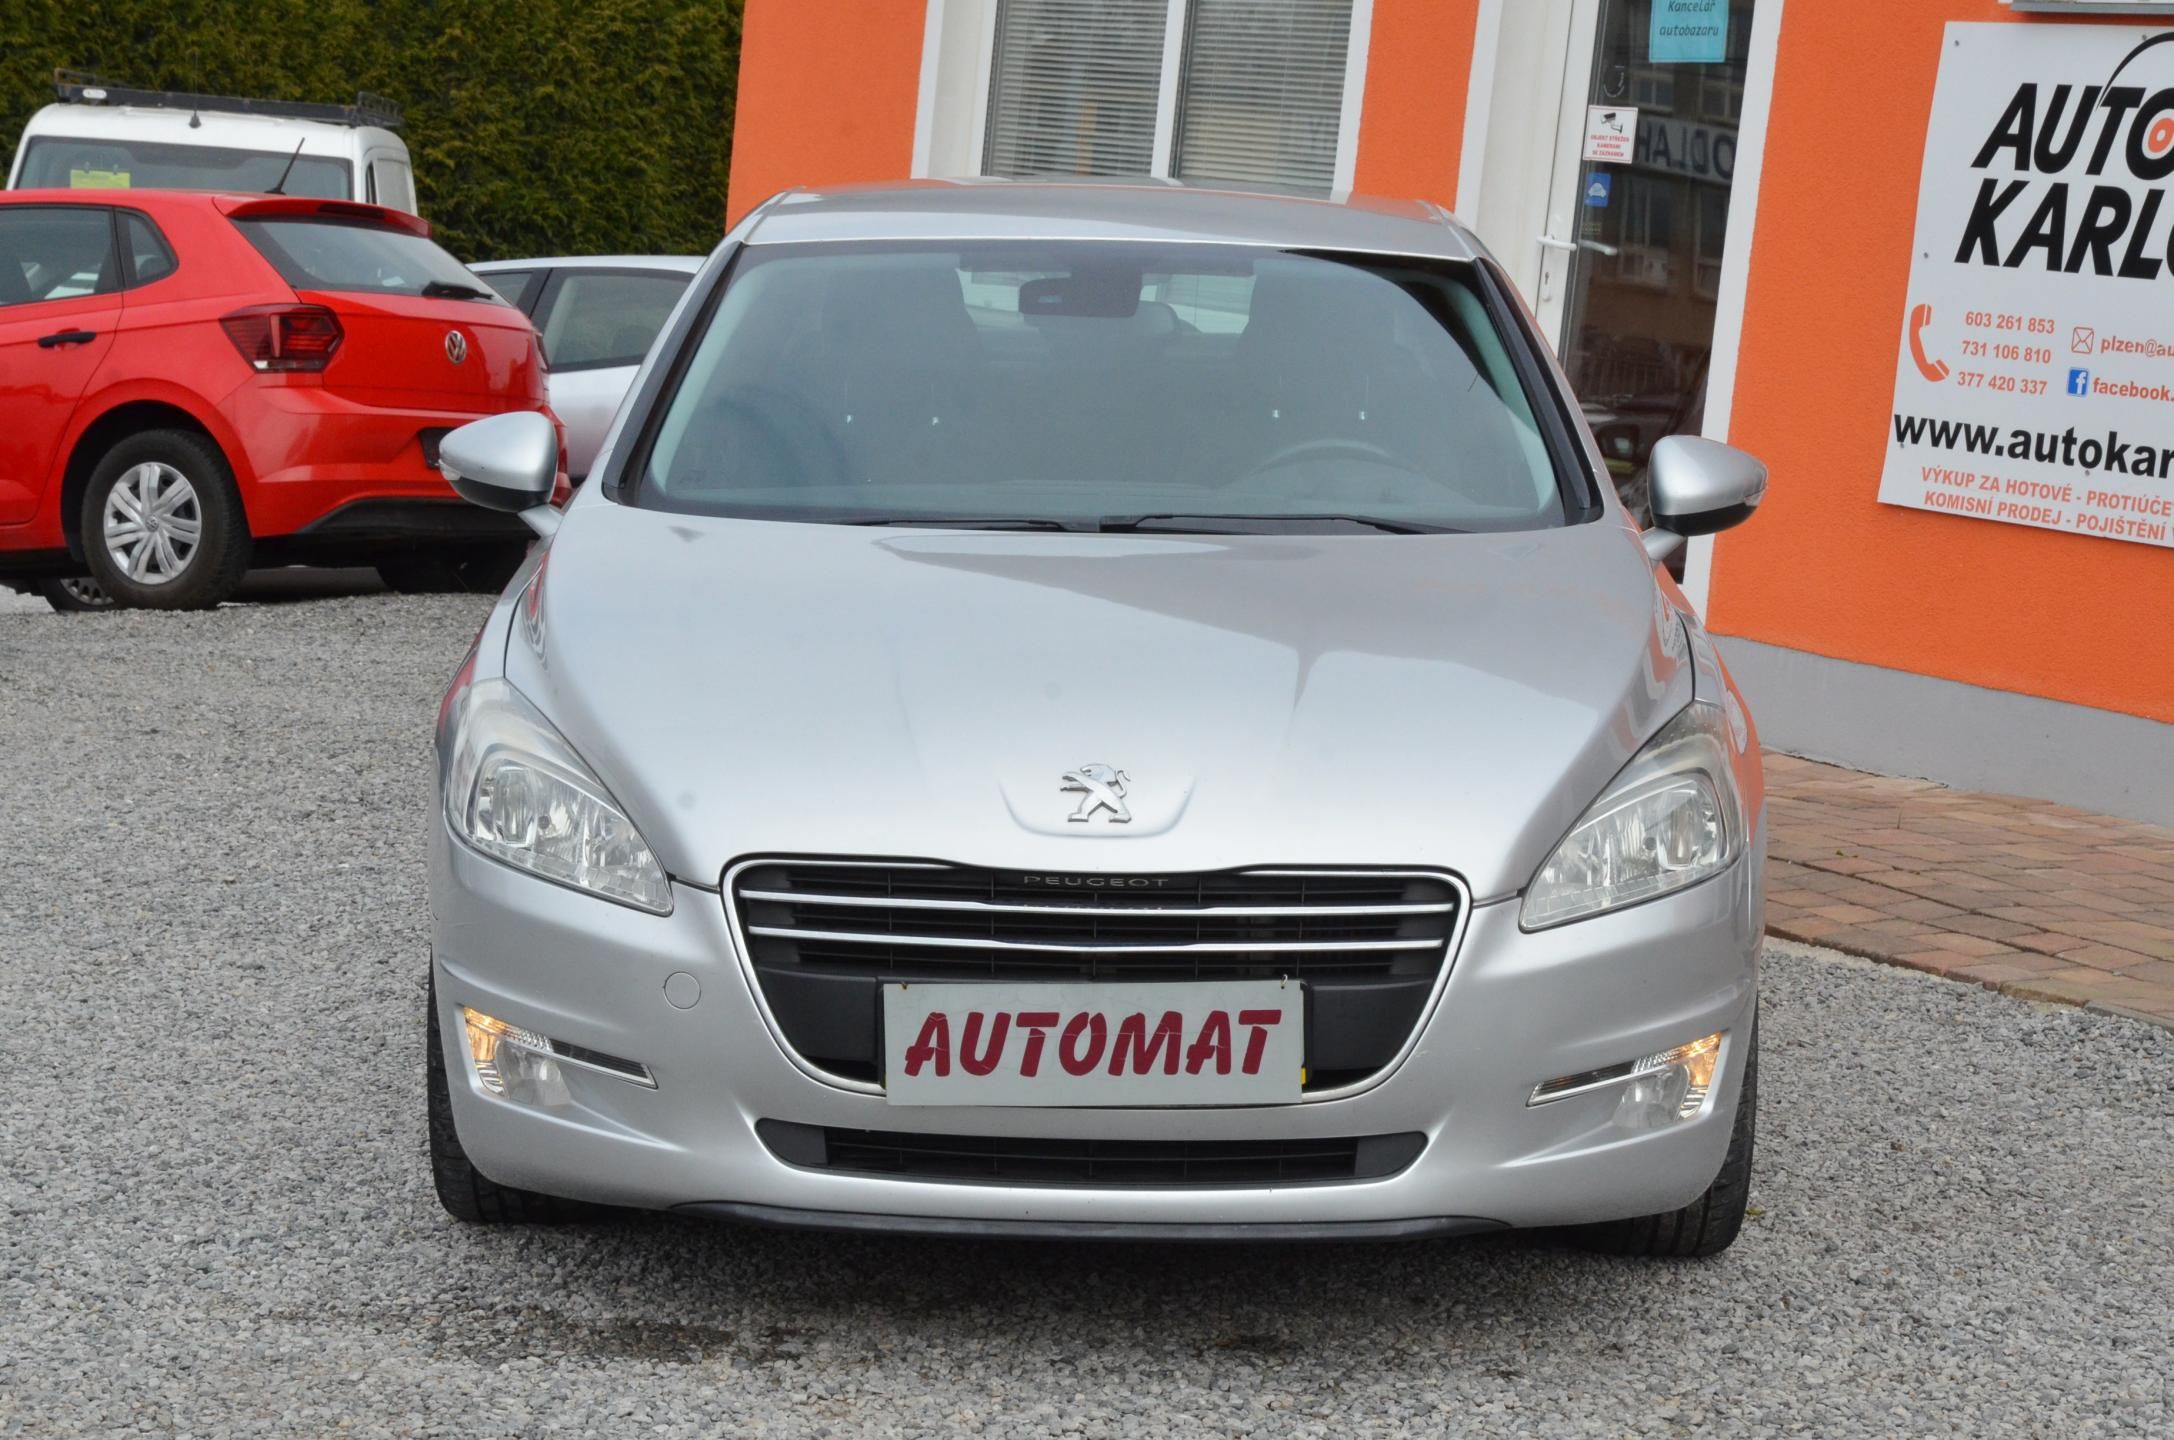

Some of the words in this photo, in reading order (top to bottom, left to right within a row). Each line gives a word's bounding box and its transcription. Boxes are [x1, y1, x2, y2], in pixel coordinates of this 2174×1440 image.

[1667, 0, 1716, 12] Kancelář
[1659, 24, 1719, 37] autobazaru
[1954, 178, 2174, 280] KARL
[1965, 311, 1992, 328] 603
[1996, 314, 2022, 331] 261
[2028, 317, 2056, 335] 853
[1962, 340, 1987, 357] 731
[1993, 343, 2019, 361] 106
[2024, 347, 2051, 364] 810
[1957, 371, 1984, 388] 377
[1988, 374, 2015, 392] 420
[2020, 378, 2048, 395] 337
[1921, 465, 1975, 487] VÝKUP
[1978, 474, 2000, 492] ZA
[2005, 479, 2073, 502] HOTOVÉ
[2086, 490, 2174, 517] PROTIÚČE
[1924, 491, 1993, 515] KOMISNÍ
[1997, 501, 2062, 525] PRODEJ
[2076, 512, 2167, 541] POJIŠTĚNÍ
[1023, 876, 1169, 888] PEUGEOT
[904, 1010, 1282, 1077] AUTOMAT
